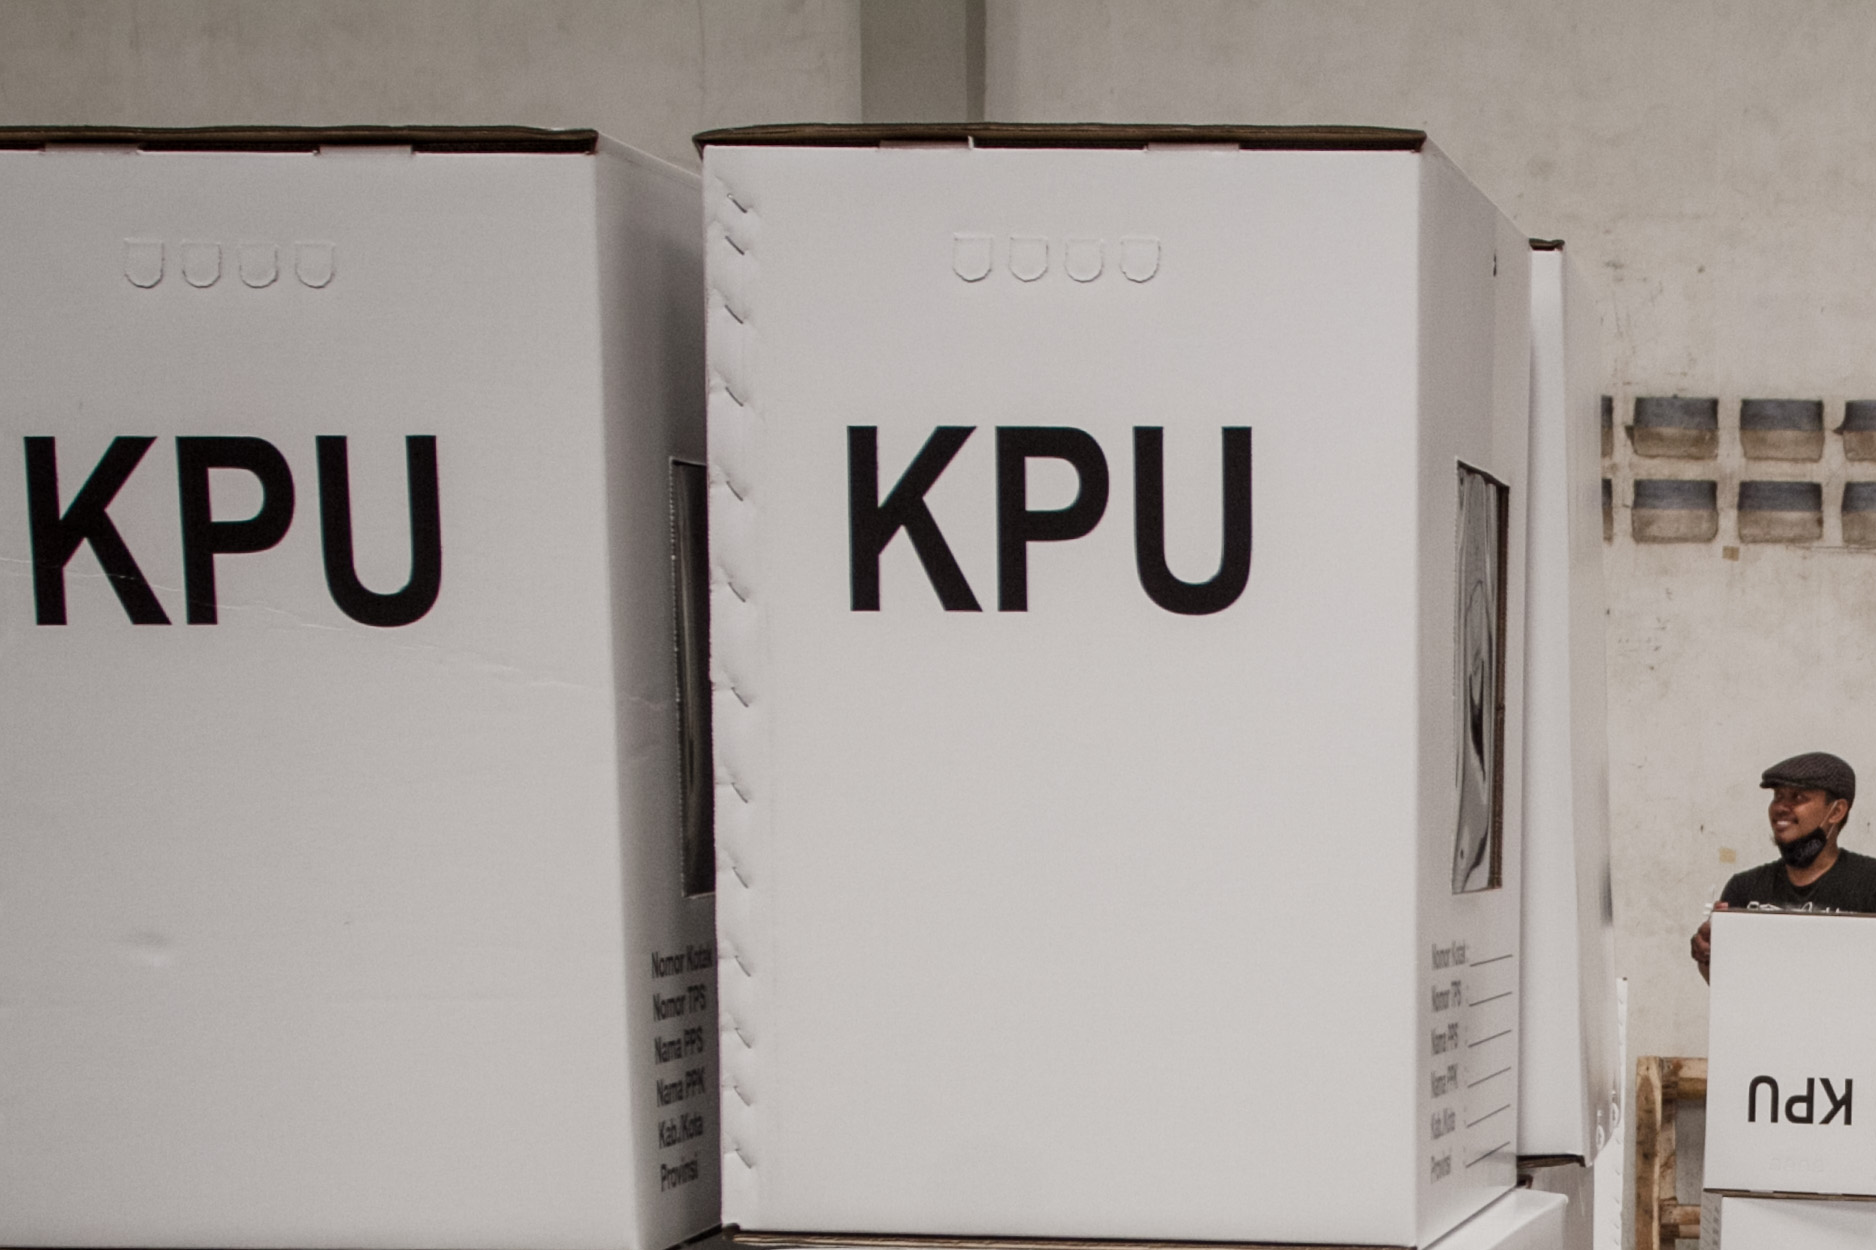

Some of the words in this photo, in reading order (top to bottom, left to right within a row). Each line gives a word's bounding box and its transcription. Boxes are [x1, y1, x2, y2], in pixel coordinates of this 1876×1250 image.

[24, 435, 441, 627] KPU
[847, 426, 1252, 615] KPU
[650, 951, 685, 979] Nomor
[685, 943, 714, 972] Kotak
[652, 992, 685, 1022] Nomor
[686, 984, 707, 1013] TPS
[654, 1035, 684, 1065] Nama
[684, 1027, 704, 1057] PPS
[656, 1078, 685, 1108] Nama
[685, 1067, 706, 1100] PPK
[1748, 1076, 1852, 1125] KPU
[658, 1113, 704, 1150] Kab./Kota
[660, 1152, 699, 1192] Provinsi
